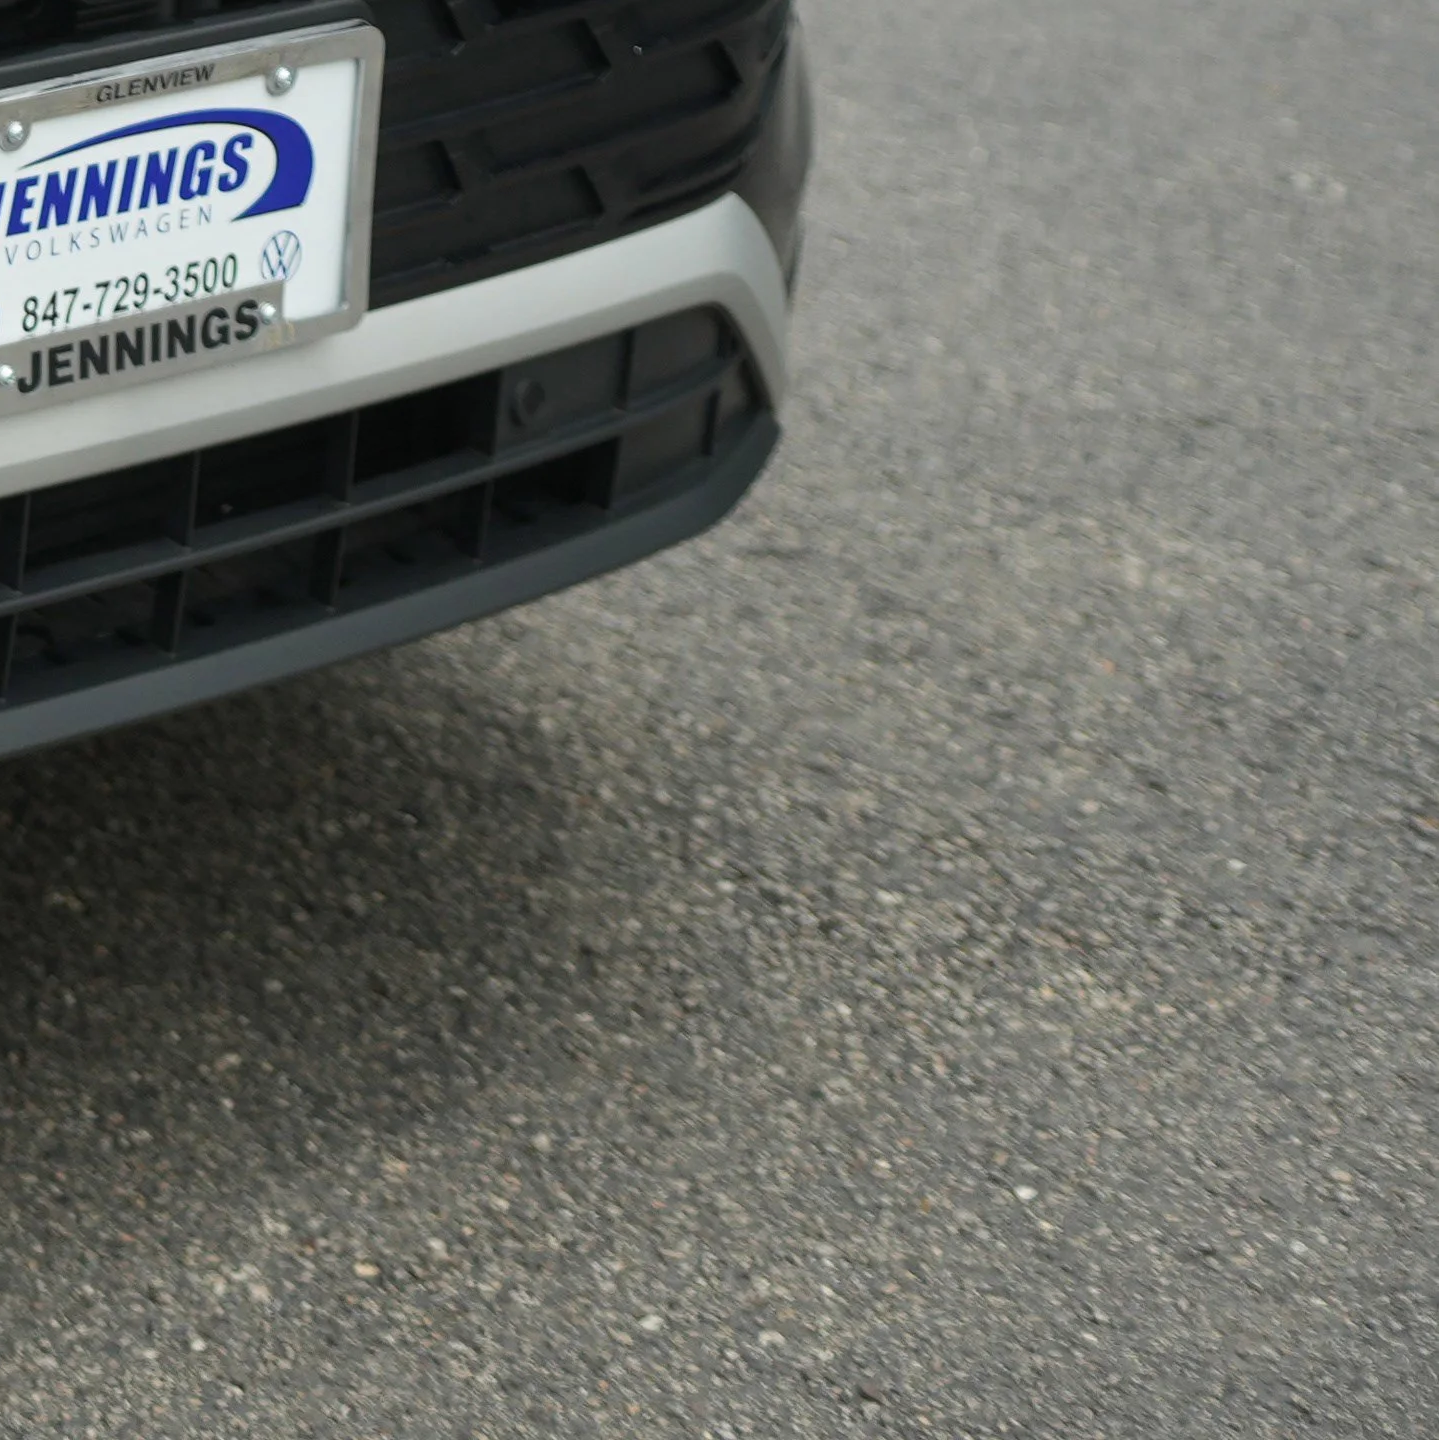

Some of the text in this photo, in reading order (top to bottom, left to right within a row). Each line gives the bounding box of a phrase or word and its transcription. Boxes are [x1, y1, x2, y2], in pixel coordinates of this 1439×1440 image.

[95, 63, 217, 104] GLENVIEW
[4, 203, 214, 266] VOLKSWAGEN
[20, 251, 239, 333] 847-729-3500
[16, 299, 260, 394] JENNINGS
